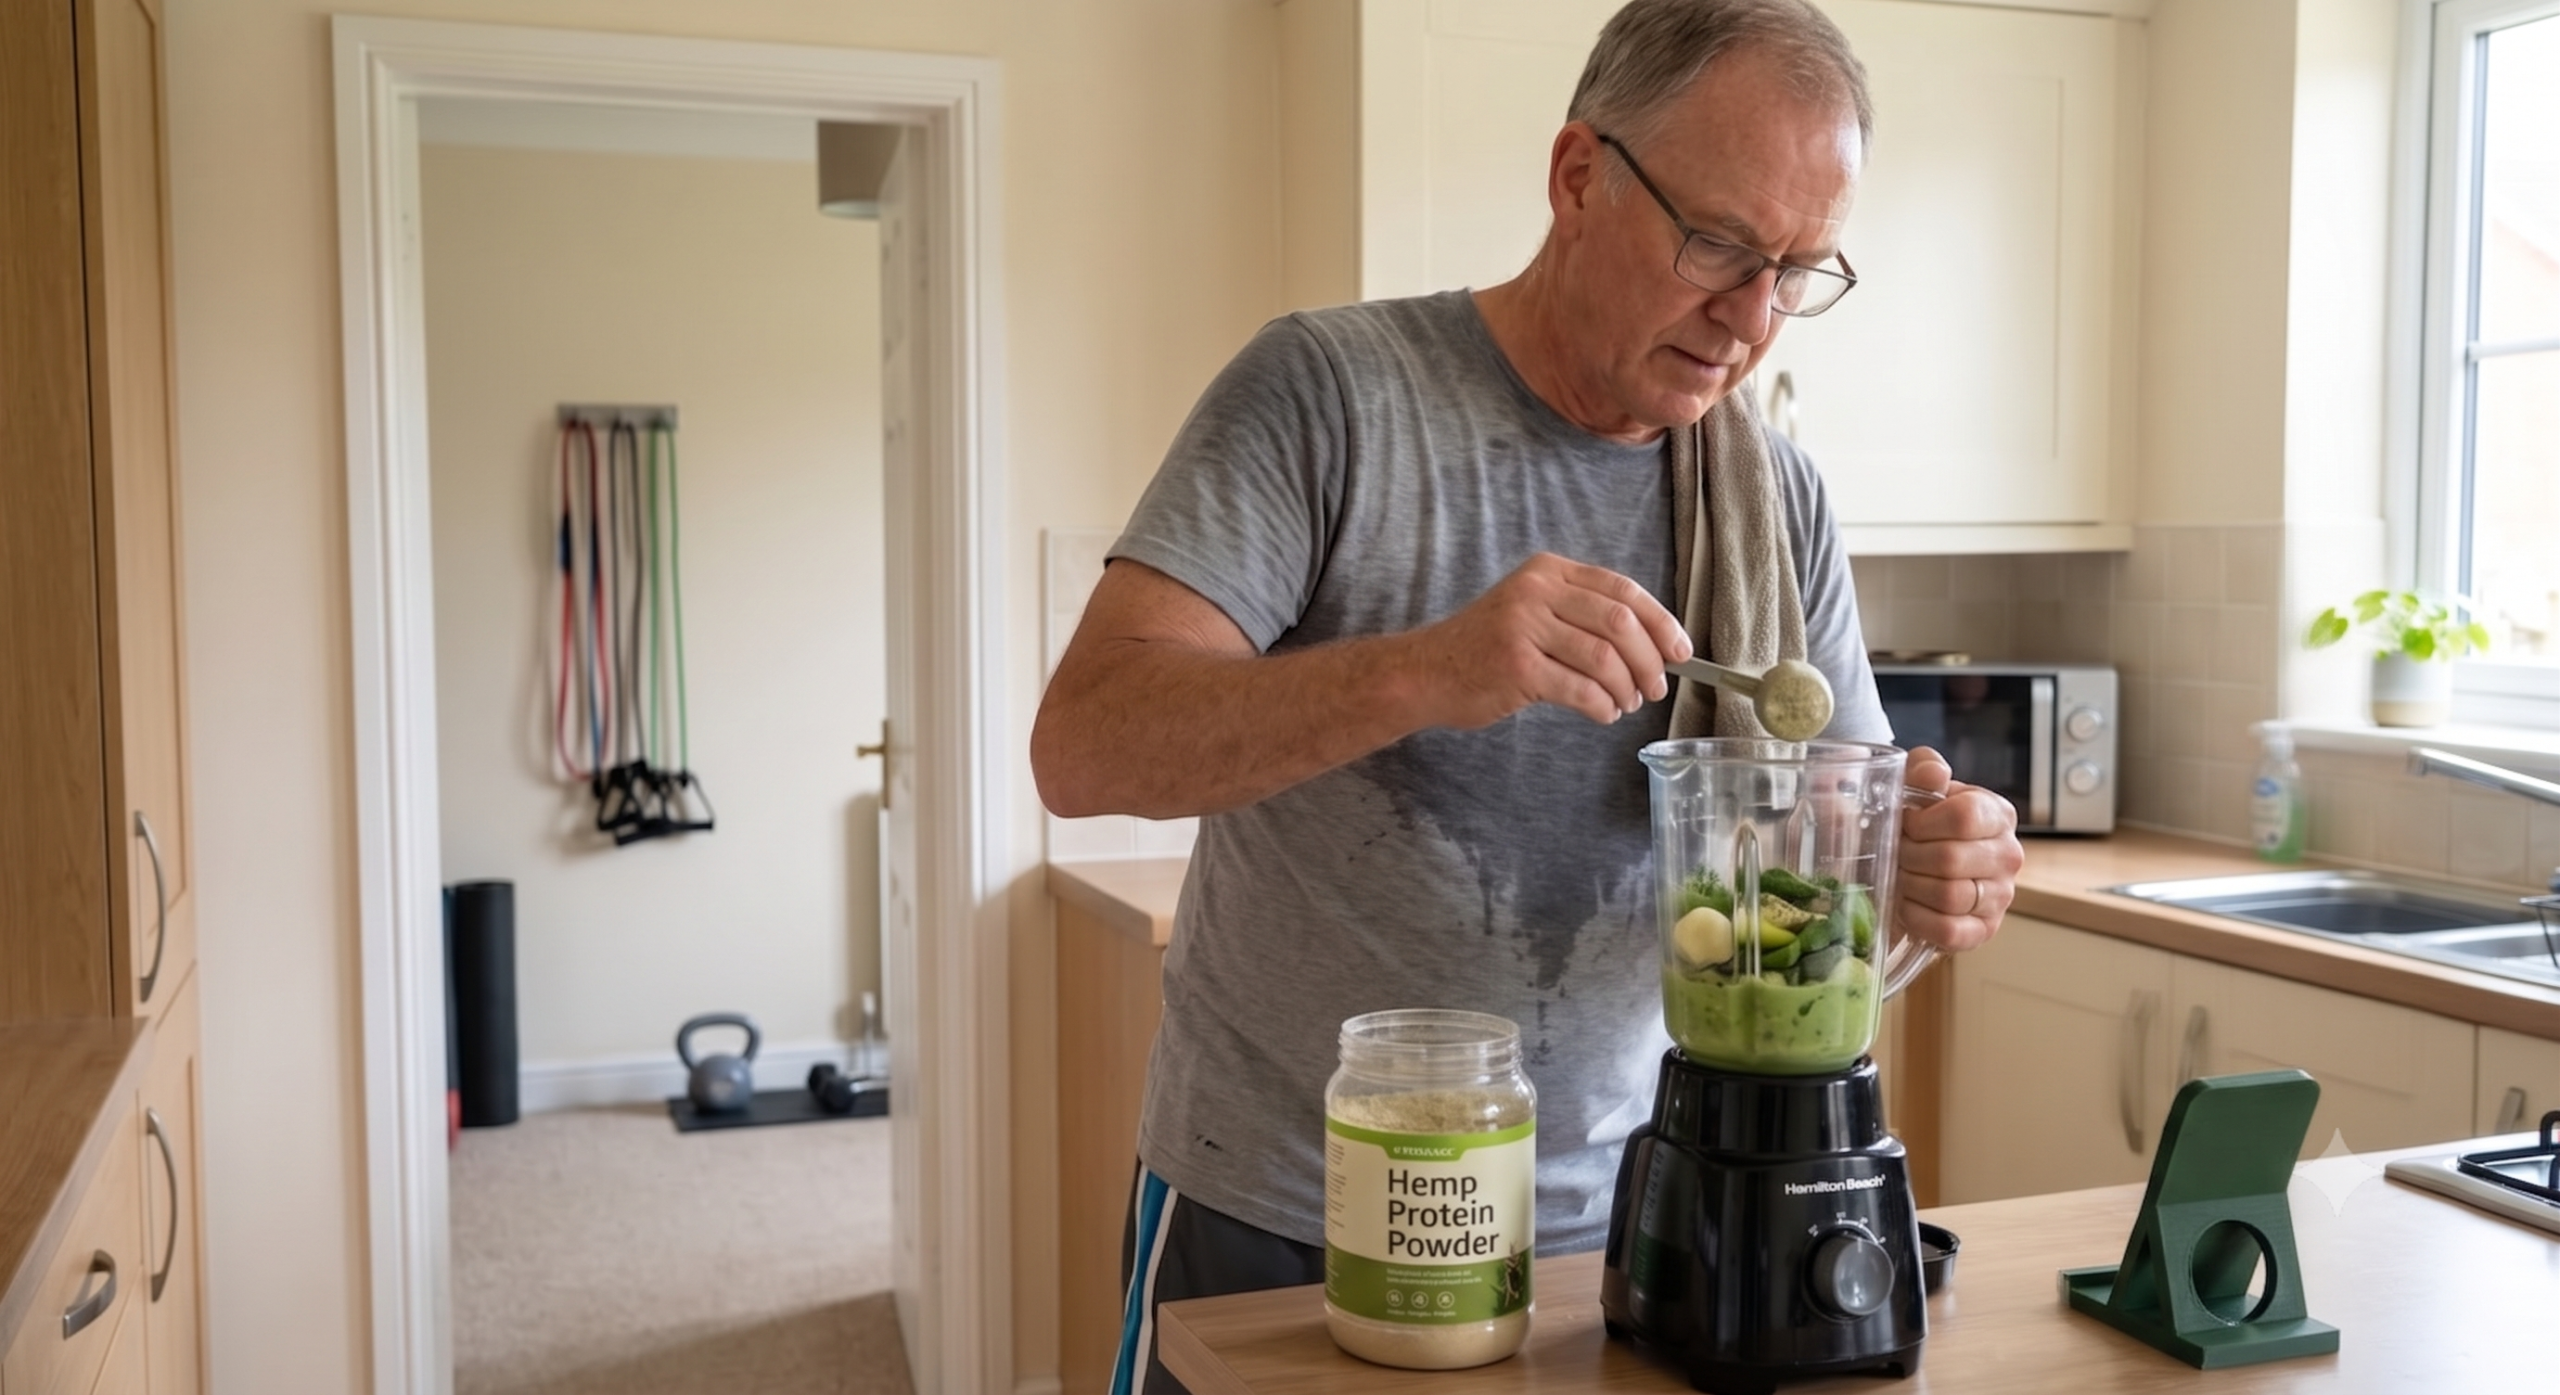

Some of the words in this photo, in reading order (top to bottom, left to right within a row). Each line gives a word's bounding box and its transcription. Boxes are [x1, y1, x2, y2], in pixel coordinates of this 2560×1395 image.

[1388, 1168, 1477, 1202] Hemp
[1846, 1175, 1884, 1190] Beach
[1388, 1199, 1494, 1227] Protein
[1388, 1229, 1500, 1257] Powder
